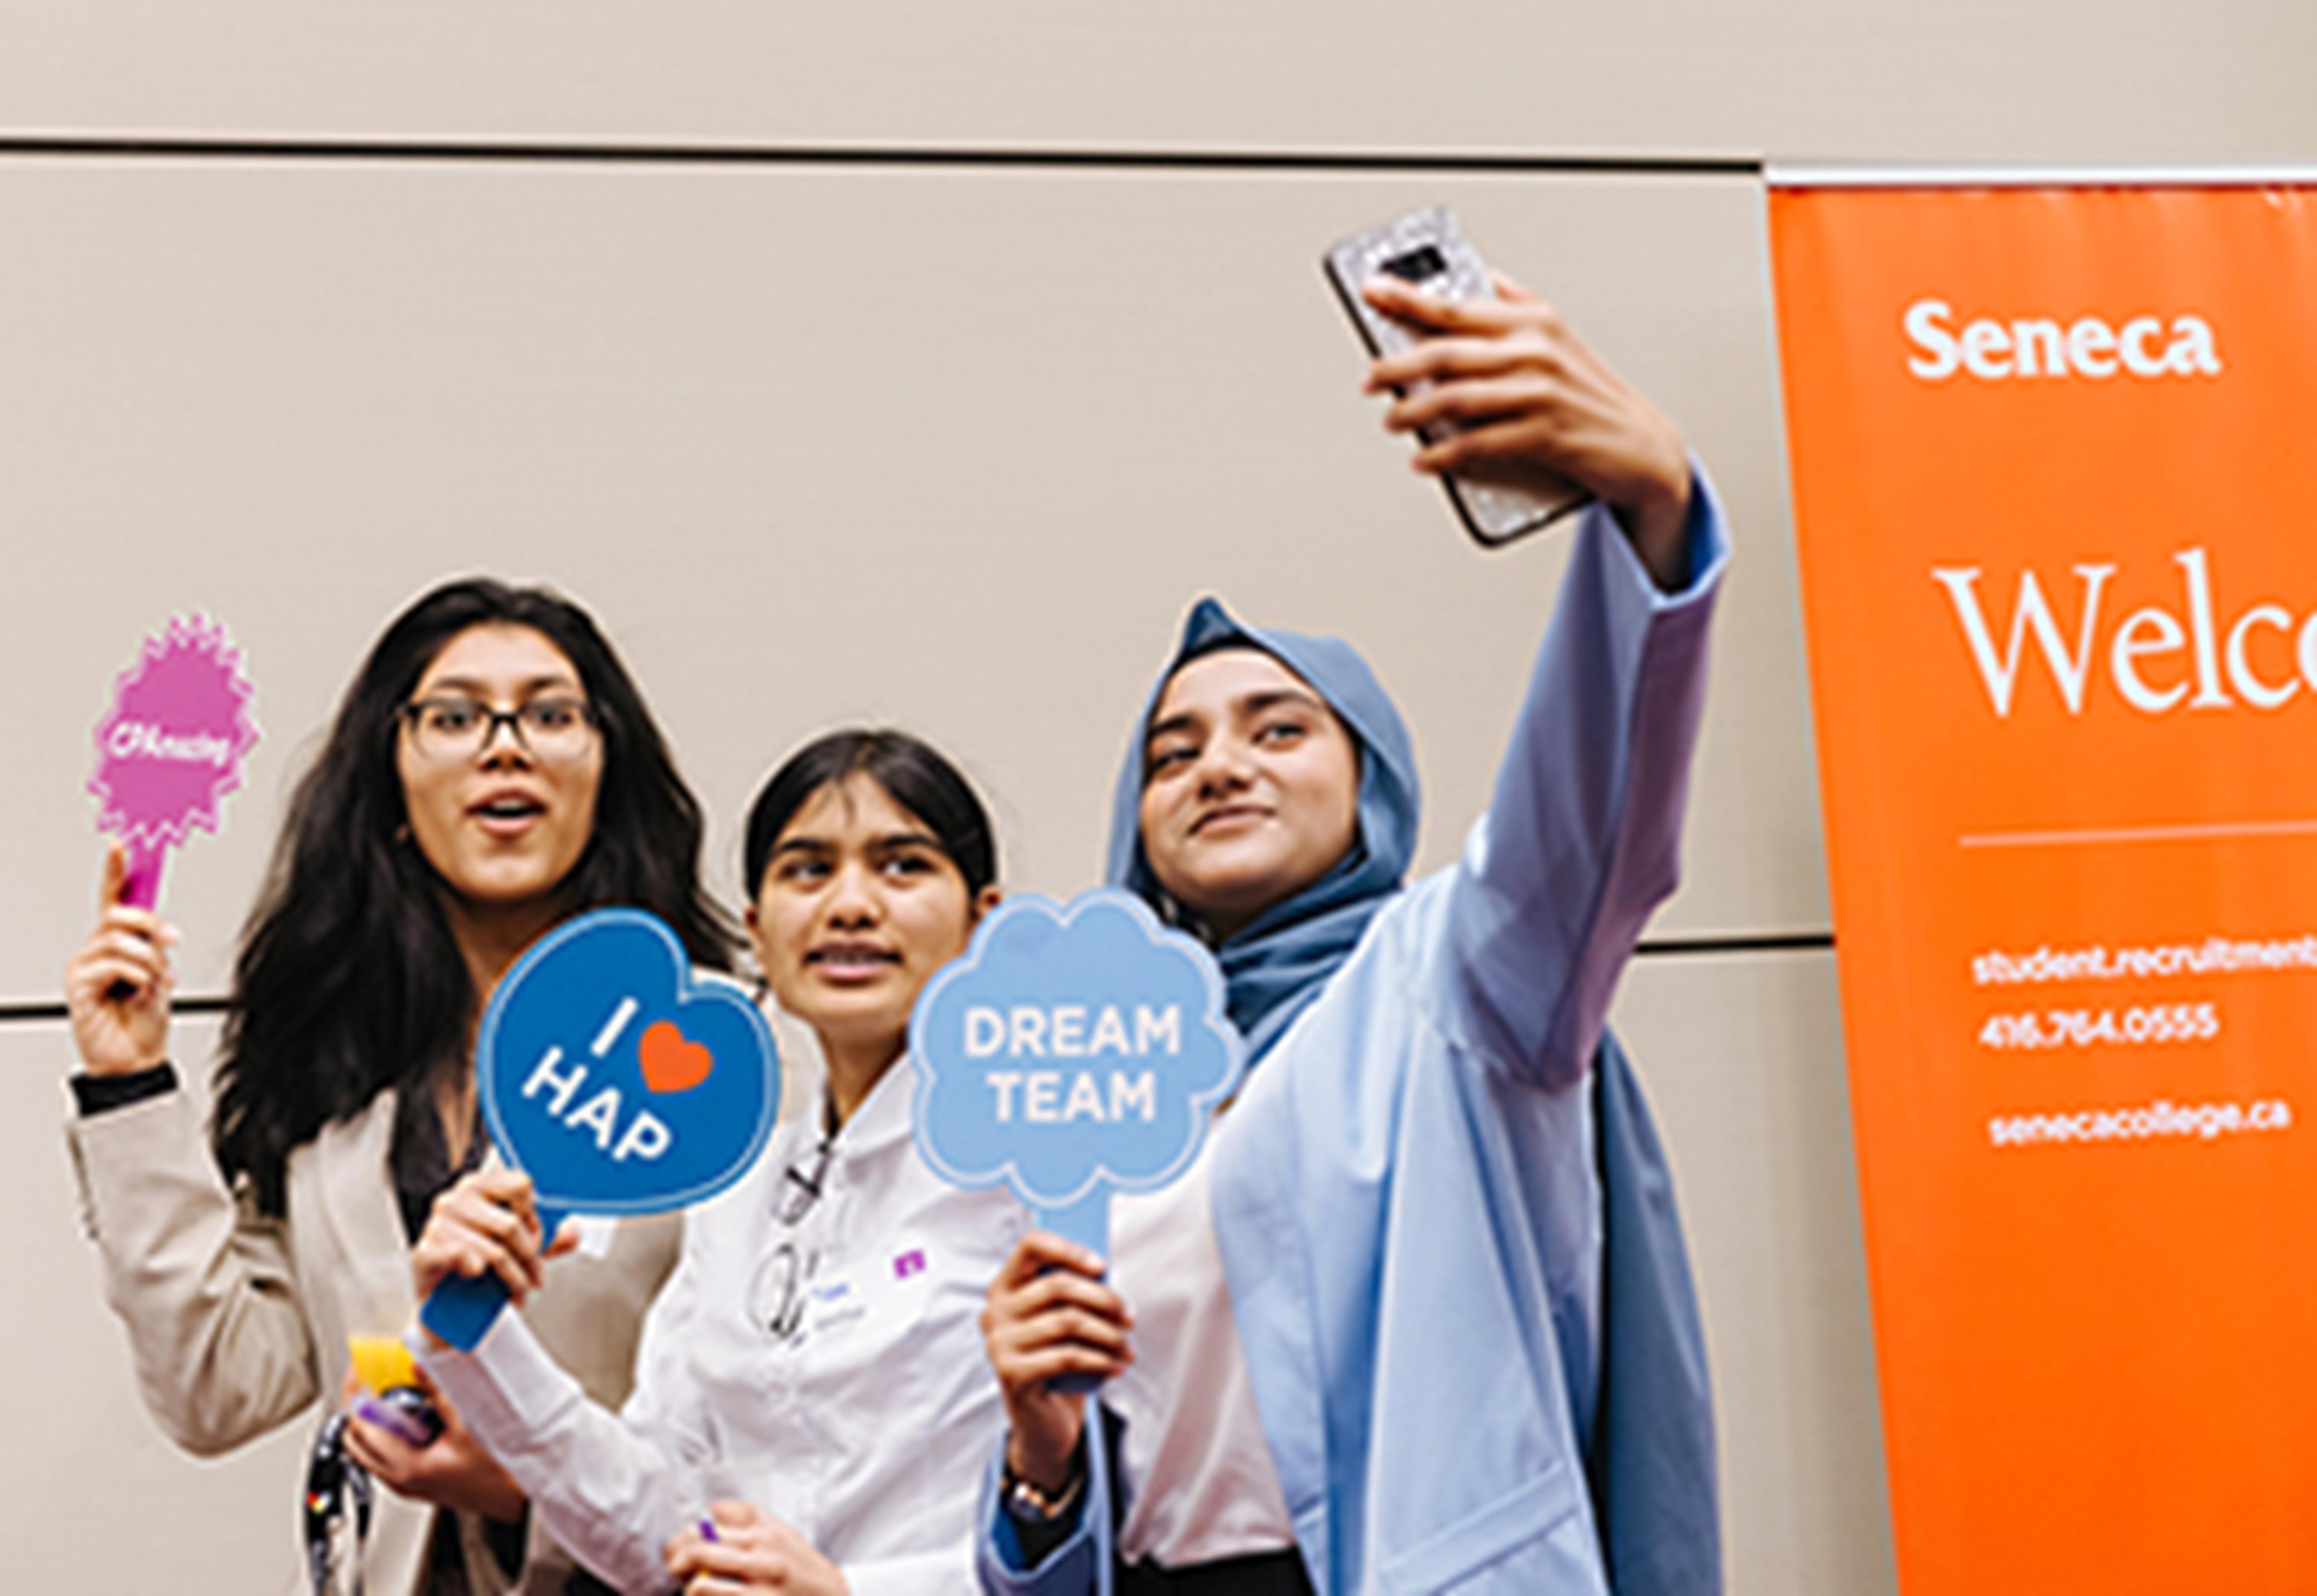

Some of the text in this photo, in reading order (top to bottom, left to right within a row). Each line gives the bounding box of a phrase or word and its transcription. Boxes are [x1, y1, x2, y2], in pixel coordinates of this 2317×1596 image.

[1904, 300, 2221, 378] Seneca
[1932, 547, 2317, 716] Welc
[591, 997, 638, 1056] I
[965, 1006, 1180, 1057] DREAM
[1979, 1003, 2219, 1048] 416.764.0555
[521, 1048, 671, 1160] HAP
[987, 1071, 1154, 1122] TEAM
[1989, 1101, 2290, 1145] senecacollege.ca
